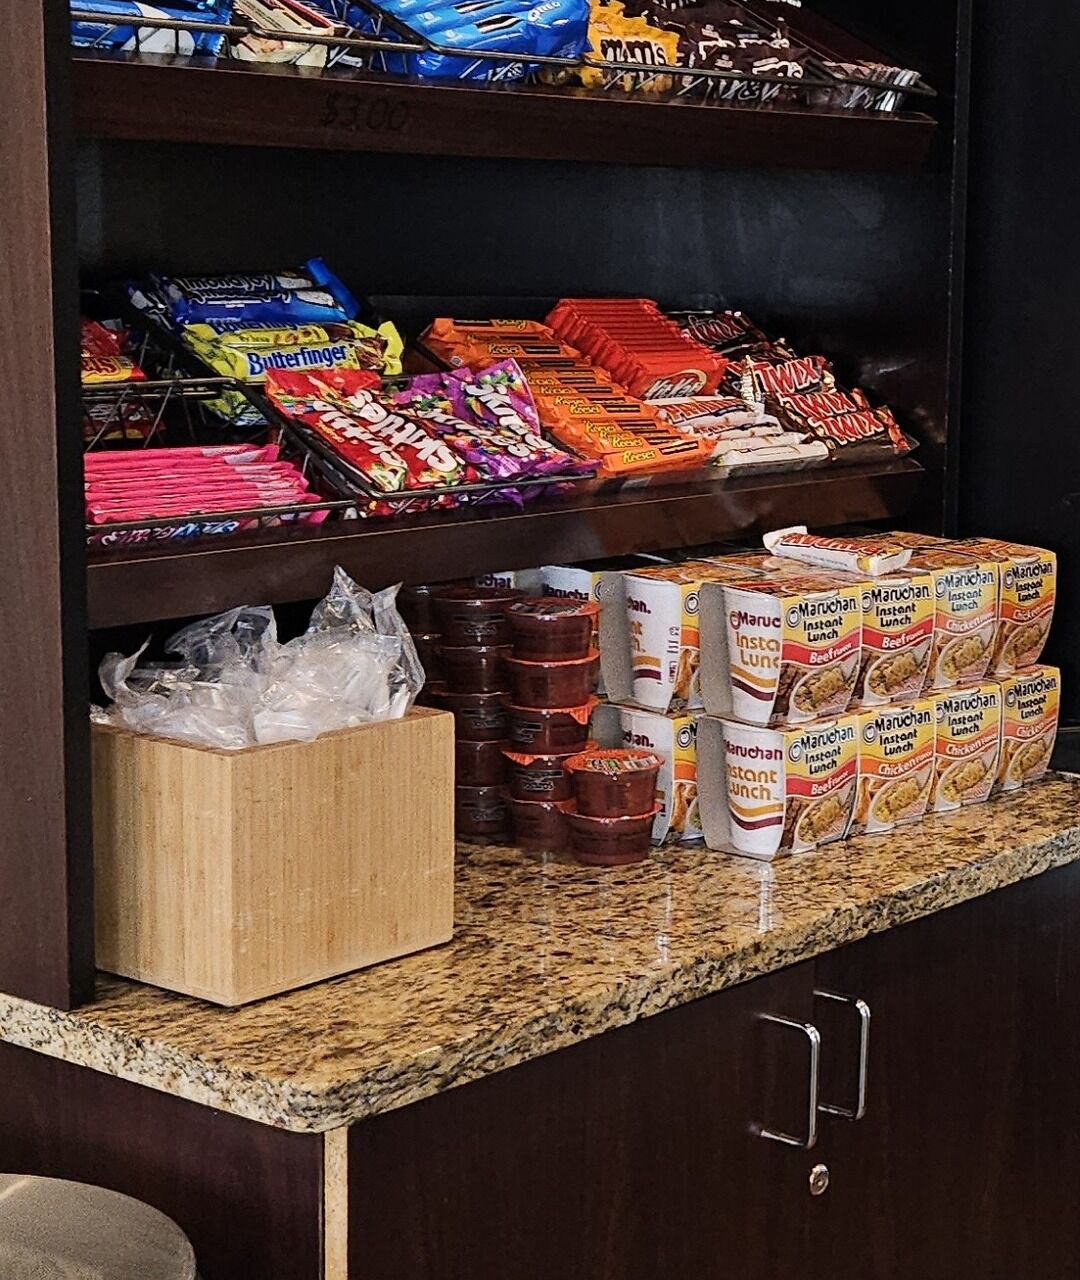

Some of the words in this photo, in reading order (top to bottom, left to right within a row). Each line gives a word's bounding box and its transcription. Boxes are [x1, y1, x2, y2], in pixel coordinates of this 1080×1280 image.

[246, 345, 348, 377] Butterfinger
[751, 358, 822, 395] TWIX
[780, 391, 857, 418] TWIX
[807, 410, 885, 446] TWIX
[1012, 561, 1054, 578] Maruchan
[944, 570, 994, 588] Maruchan
[1015, 578, 1044, 592] Instant
[871, 586, 930, 604] Maruchan
[948, 588, 982, 602] Instant
[1018, 591, 1041, 602] Lunch
[798, 598, 857, 618] Maruchan
[876, 603, 917, 617] Instant
[951, 601, 979, 612] Lunch
[803, 616, 843, 632] Instant
[880, 614, 912, 628] Lunch
[807, 629, 839, 643] Lunch
[882, 632, 906, 649] Beef
[809, 648, 834, 665] Beef
[1014, 677, 1057, 698] Maruchan
[944, 693, 996, 713] Maruchan
[1017, 694, 1047, 710] Instant
[874, 710, 931, 732] Maruchan
[948, 711, 984, 726] Instant
[1021, 707, 1044, 719] Lunch
[800, 725, 854, 751] Maruchan
[879, 728, 918, 746] Instant
[951, 723, 980, 737] Lunch
[805, 746, 842, 763] Instant
[884, 741, 914, 756] Lunch
[946, 740, 982, 756] Chicken
[809, 759, 838, 775] Lunch
[878, 758, 916, 775] Chicken
[810, 779, 833, 795] Beef
